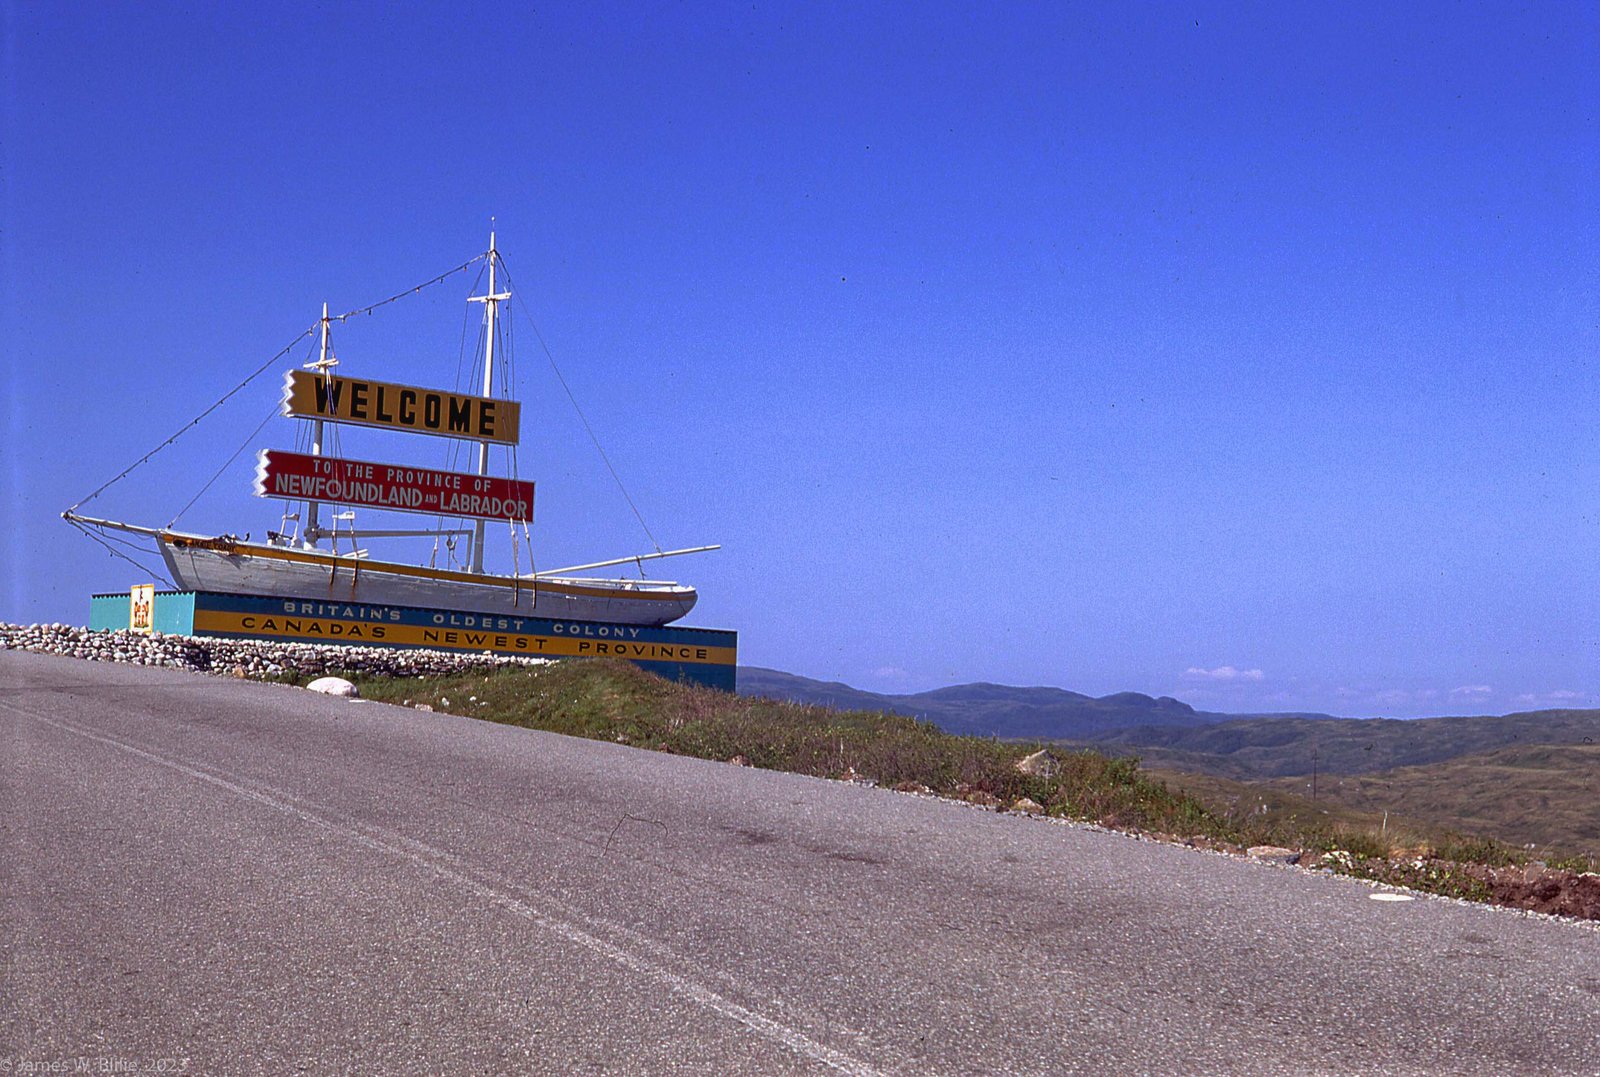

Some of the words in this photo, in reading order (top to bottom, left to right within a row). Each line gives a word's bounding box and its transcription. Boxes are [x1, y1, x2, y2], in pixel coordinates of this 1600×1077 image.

[314, 376, 496, 436] WELCOME
[275, 473, 422, 507] NEWFOUNDLAND
[425, 493, 438, 504] AND
[440, 491, 527, 518] LABRADOR
[313, 459, 331, 474] TO
[346, 463, 374, 480] THE
[387, 468, 461, 489] PROVINCE
[474, 480, 491, 492] OF
[241, 617, 386, 638] CANADA'S
[423, 630, 548, 650] NEWEST
[578, 641, 708, 660] PROVINCE
[284, 601, 401, 621] BRITAIN'S
[432, 614, 525, 631] OLDEST
[553, 623, 641, 638] COLONY
